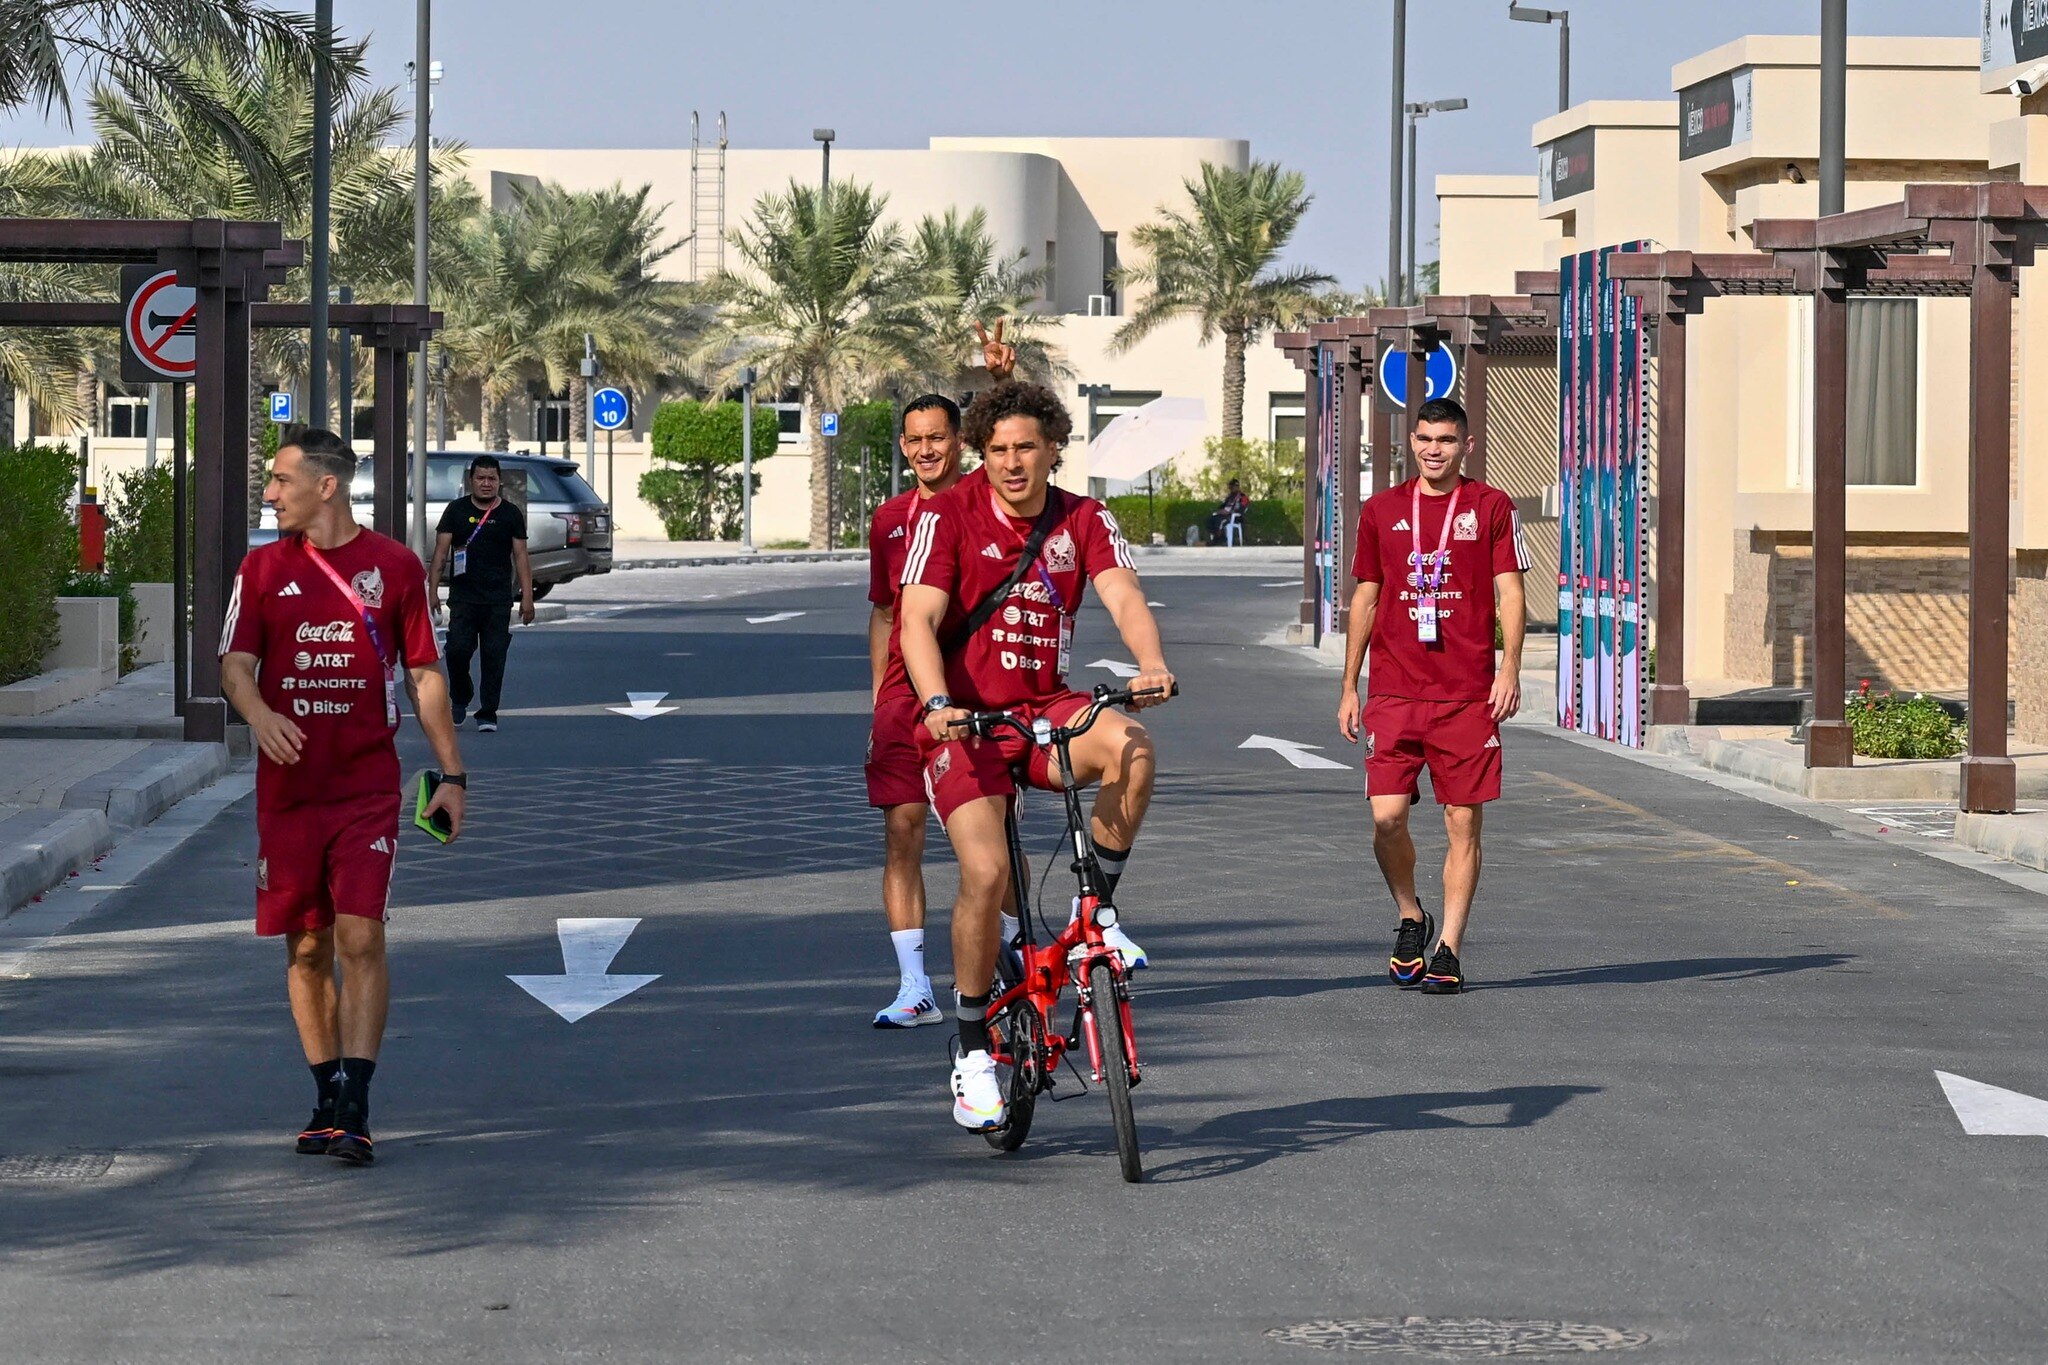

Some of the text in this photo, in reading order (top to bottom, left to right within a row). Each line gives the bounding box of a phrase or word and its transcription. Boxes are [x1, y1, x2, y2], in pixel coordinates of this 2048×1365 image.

[275, 395, 288, 412] P
[600, 392, 616, 405] ١٠
[601, 410, 618, 423] 10
[824, 415, 835, 429] P
[296, 621, 355, 643] Coca-Cola
[313, 653, 352, 668] AT&T
[298, 678, 367, 690] BANORTE
[312, 700, 350, 715] Bitso
